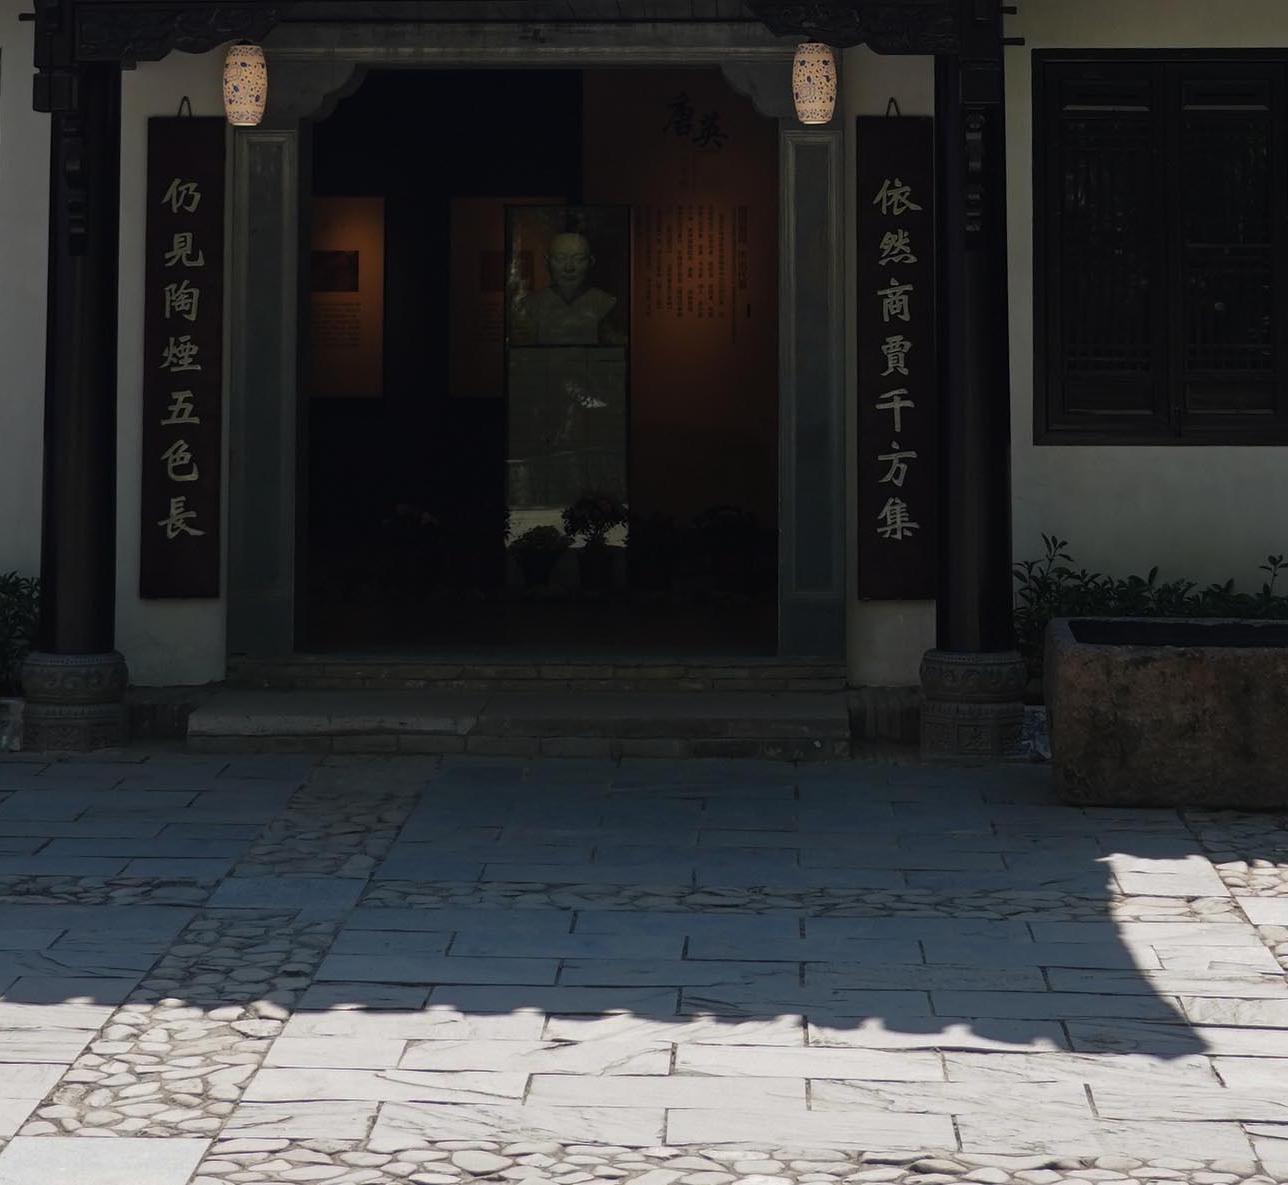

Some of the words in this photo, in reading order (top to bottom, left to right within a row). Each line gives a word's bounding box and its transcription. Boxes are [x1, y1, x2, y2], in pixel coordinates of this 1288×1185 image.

[873, 176, 923, 541] 依然商賈千方集
